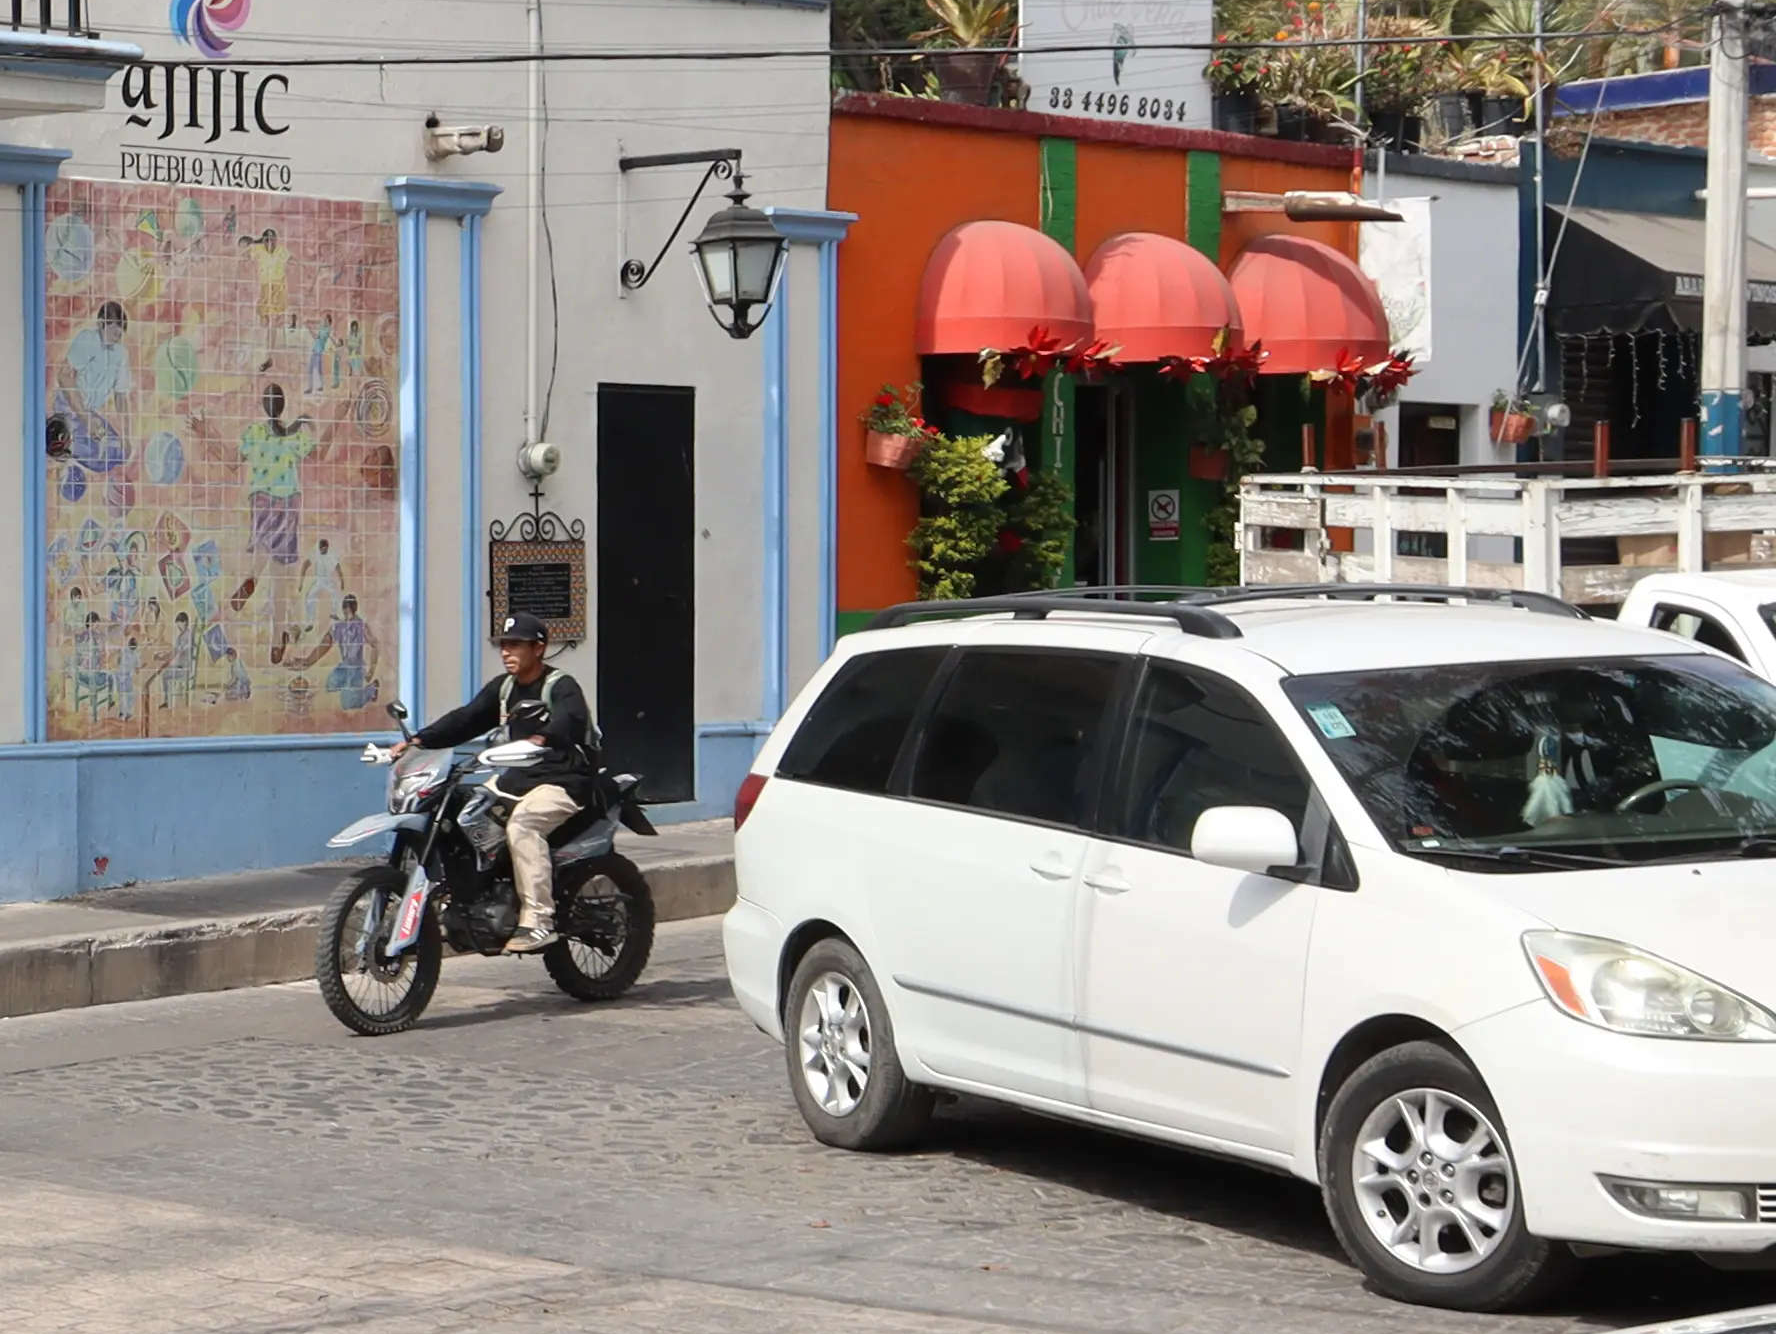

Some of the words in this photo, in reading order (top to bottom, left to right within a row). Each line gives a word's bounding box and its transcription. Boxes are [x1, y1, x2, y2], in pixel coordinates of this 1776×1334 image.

[1049, 86, 1073, 109] 33
[1081, 90, 1130, 116] 4496
[1137, 96, 1187, 122] 8034
